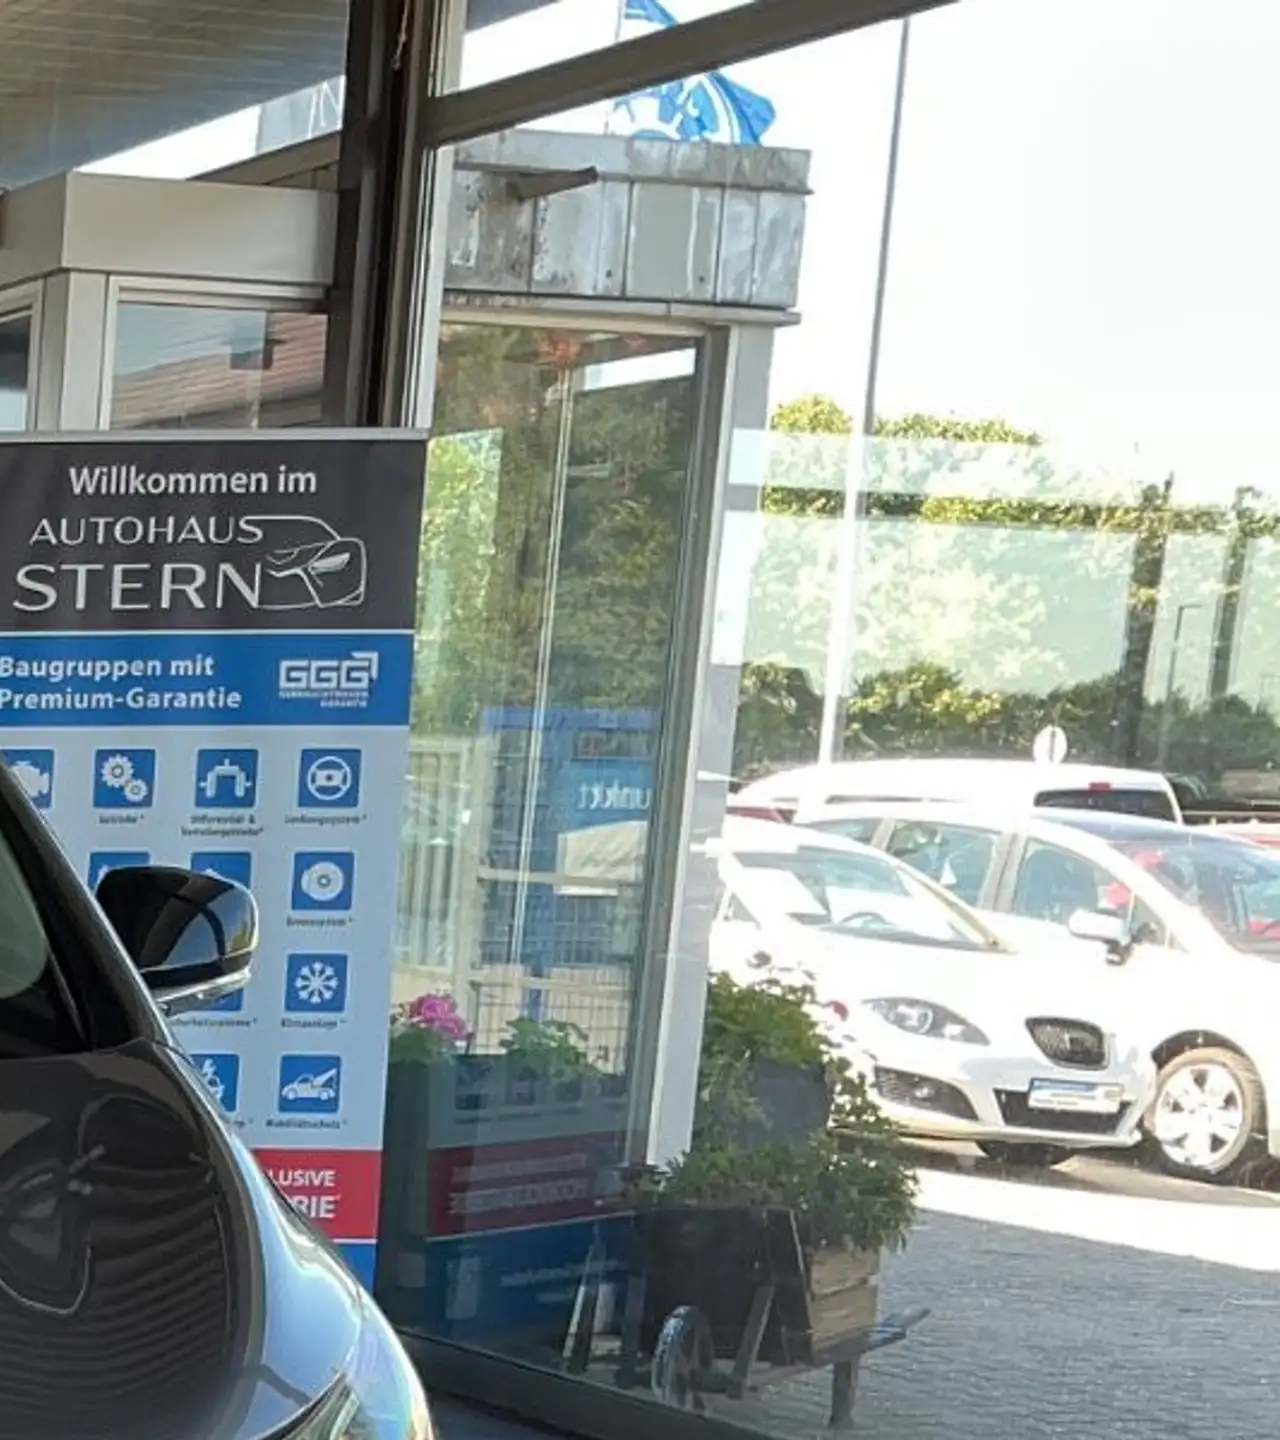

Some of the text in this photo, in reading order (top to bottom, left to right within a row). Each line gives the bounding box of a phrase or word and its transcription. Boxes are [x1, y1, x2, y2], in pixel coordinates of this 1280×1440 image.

[70, 466, 317, 497] Willkommen im
[28, 515, 264, 545] AUTOHAUS
[12, 562, 261, 612] STERN
[169, 655, 215, 678] mit
[279, 659, 370, 689] GGG
